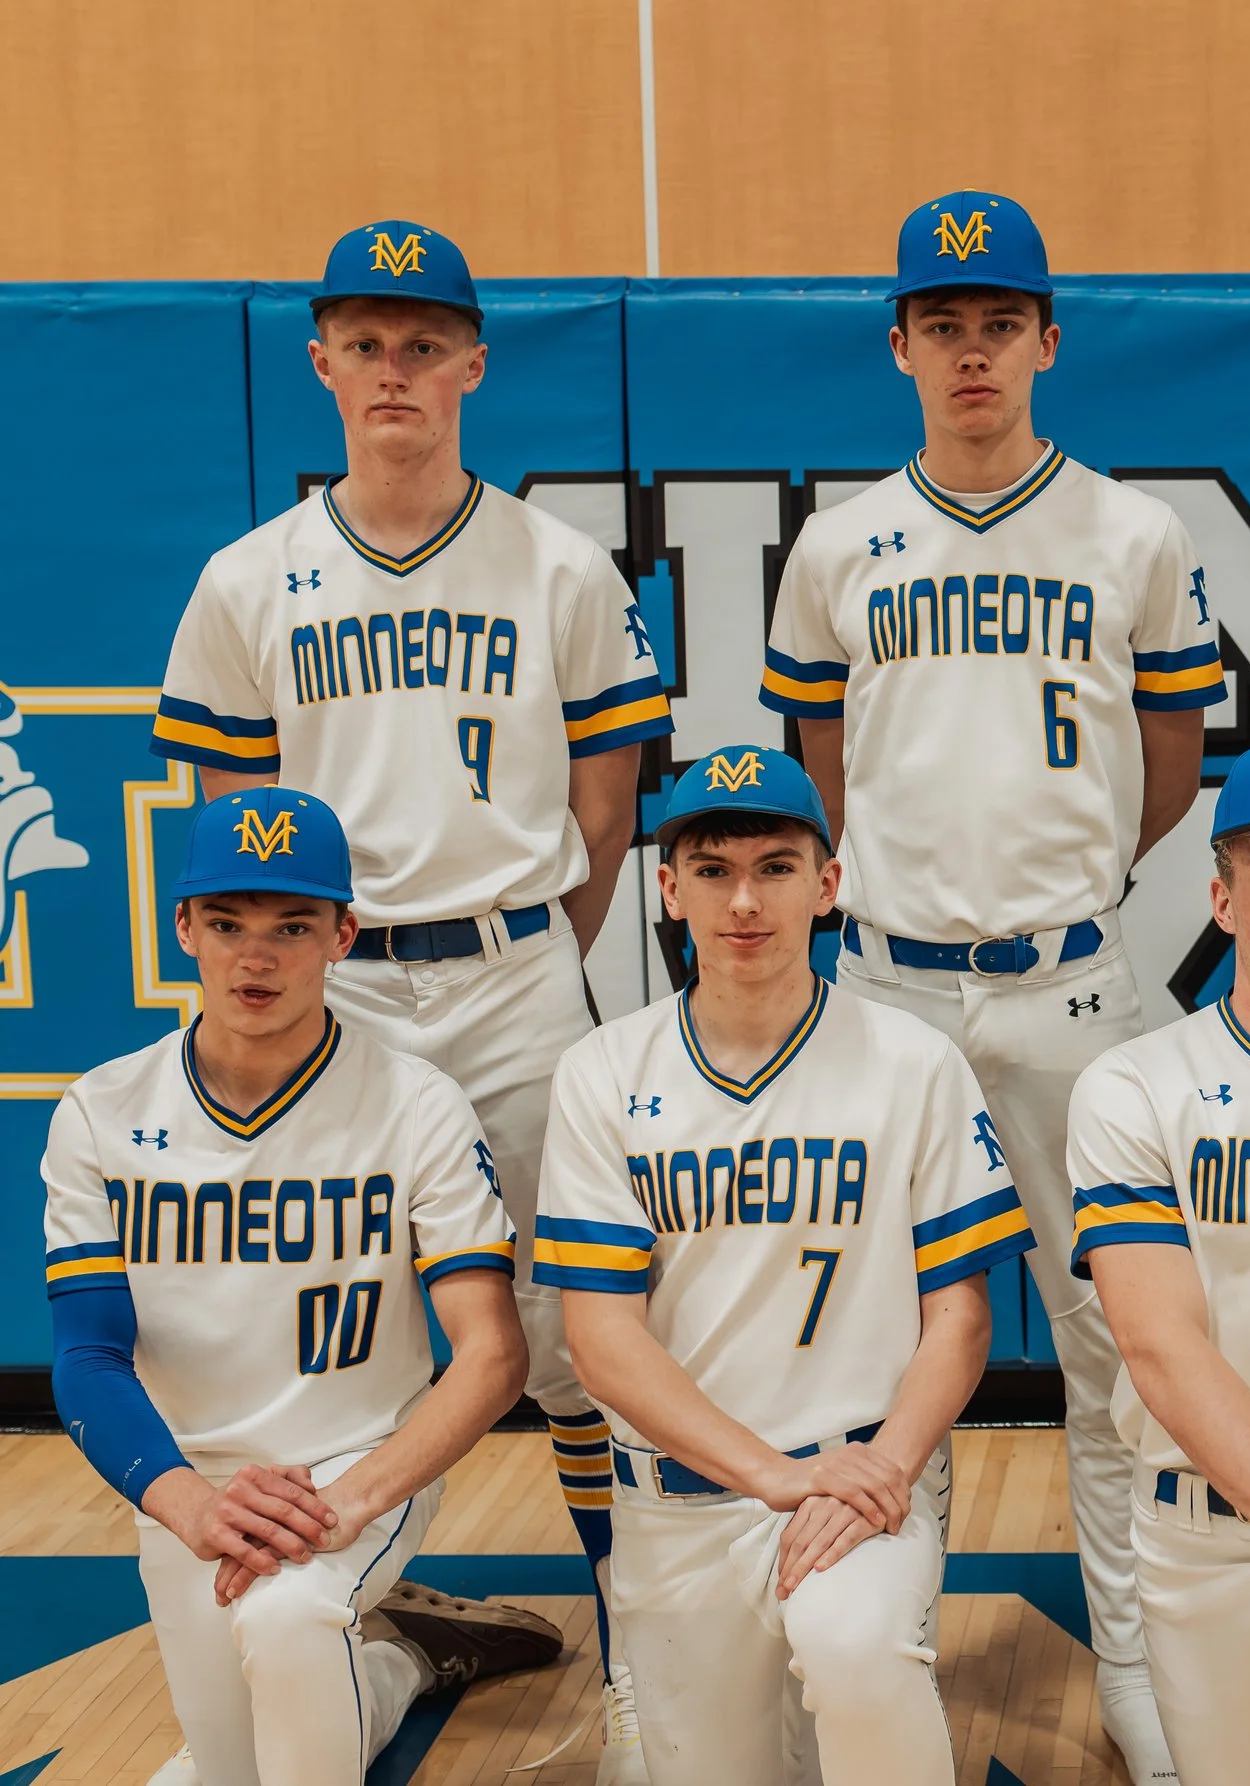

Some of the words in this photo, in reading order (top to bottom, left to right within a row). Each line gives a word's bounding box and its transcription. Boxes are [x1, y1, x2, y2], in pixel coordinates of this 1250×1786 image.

[290, 608, 519, 706] MINNEOTA
[868, 573, 1095, 668] MINNEOTA
[455, 714, 496, 804] 9
[1040, 678, 1080, 771] 6
[625, 1136, 870, 1234] MINNEOTA
[296, 1279, 384, 1377] 00
[794, 1247, 844, 1349] 7
